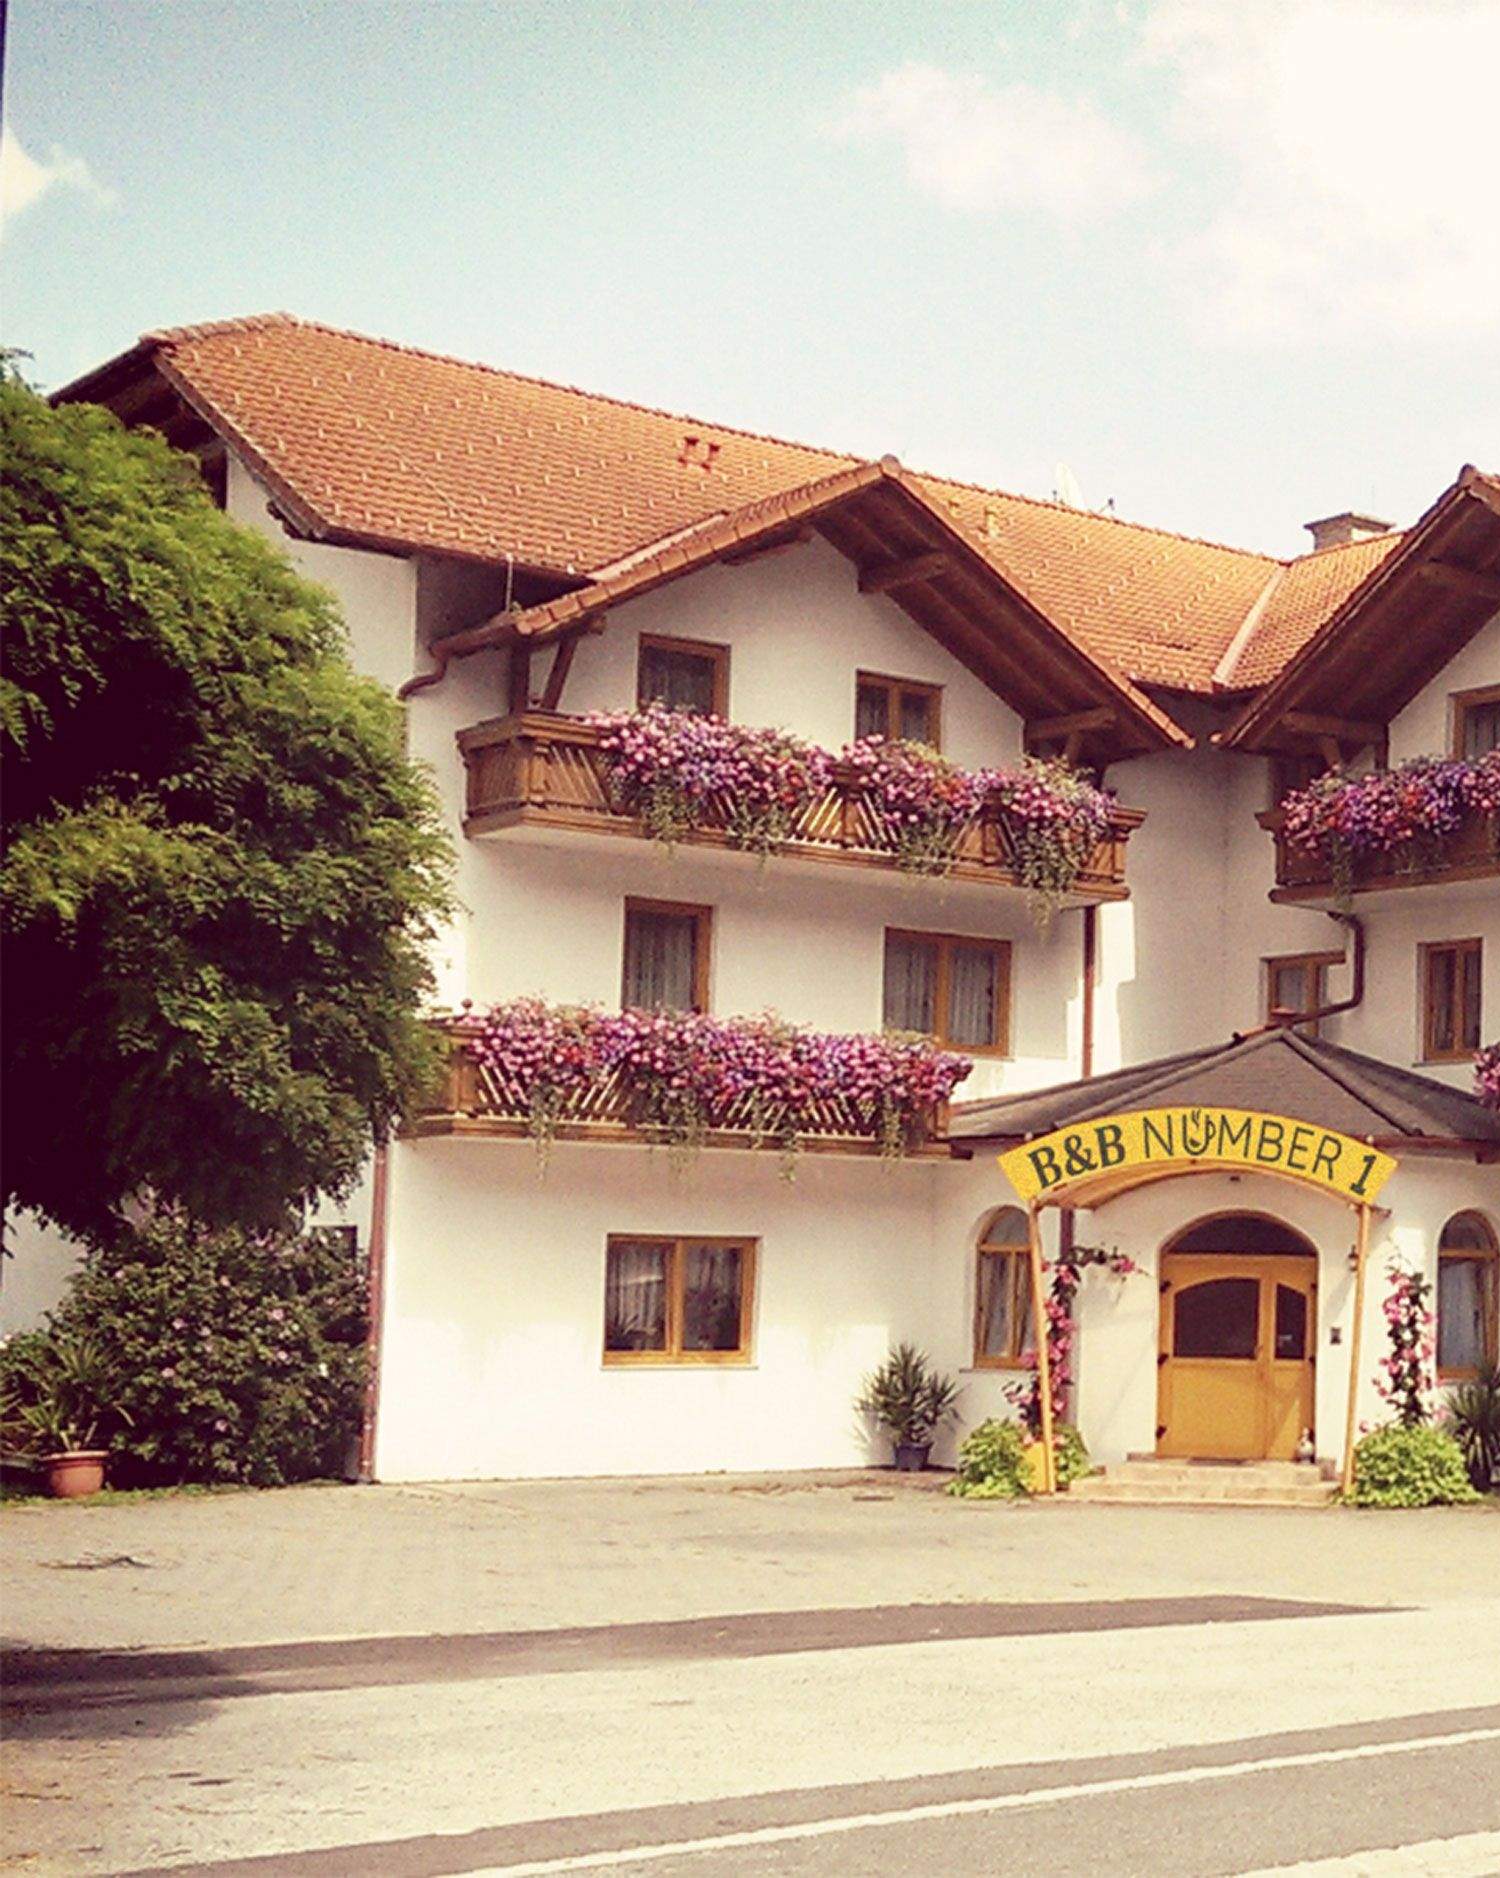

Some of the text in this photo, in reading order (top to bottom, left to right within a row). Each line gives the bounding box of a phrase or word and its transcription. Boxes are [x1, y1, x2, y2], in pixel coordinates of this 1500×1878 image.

[1028, 1109, 1378, 1195] B&B NUMBER 1
